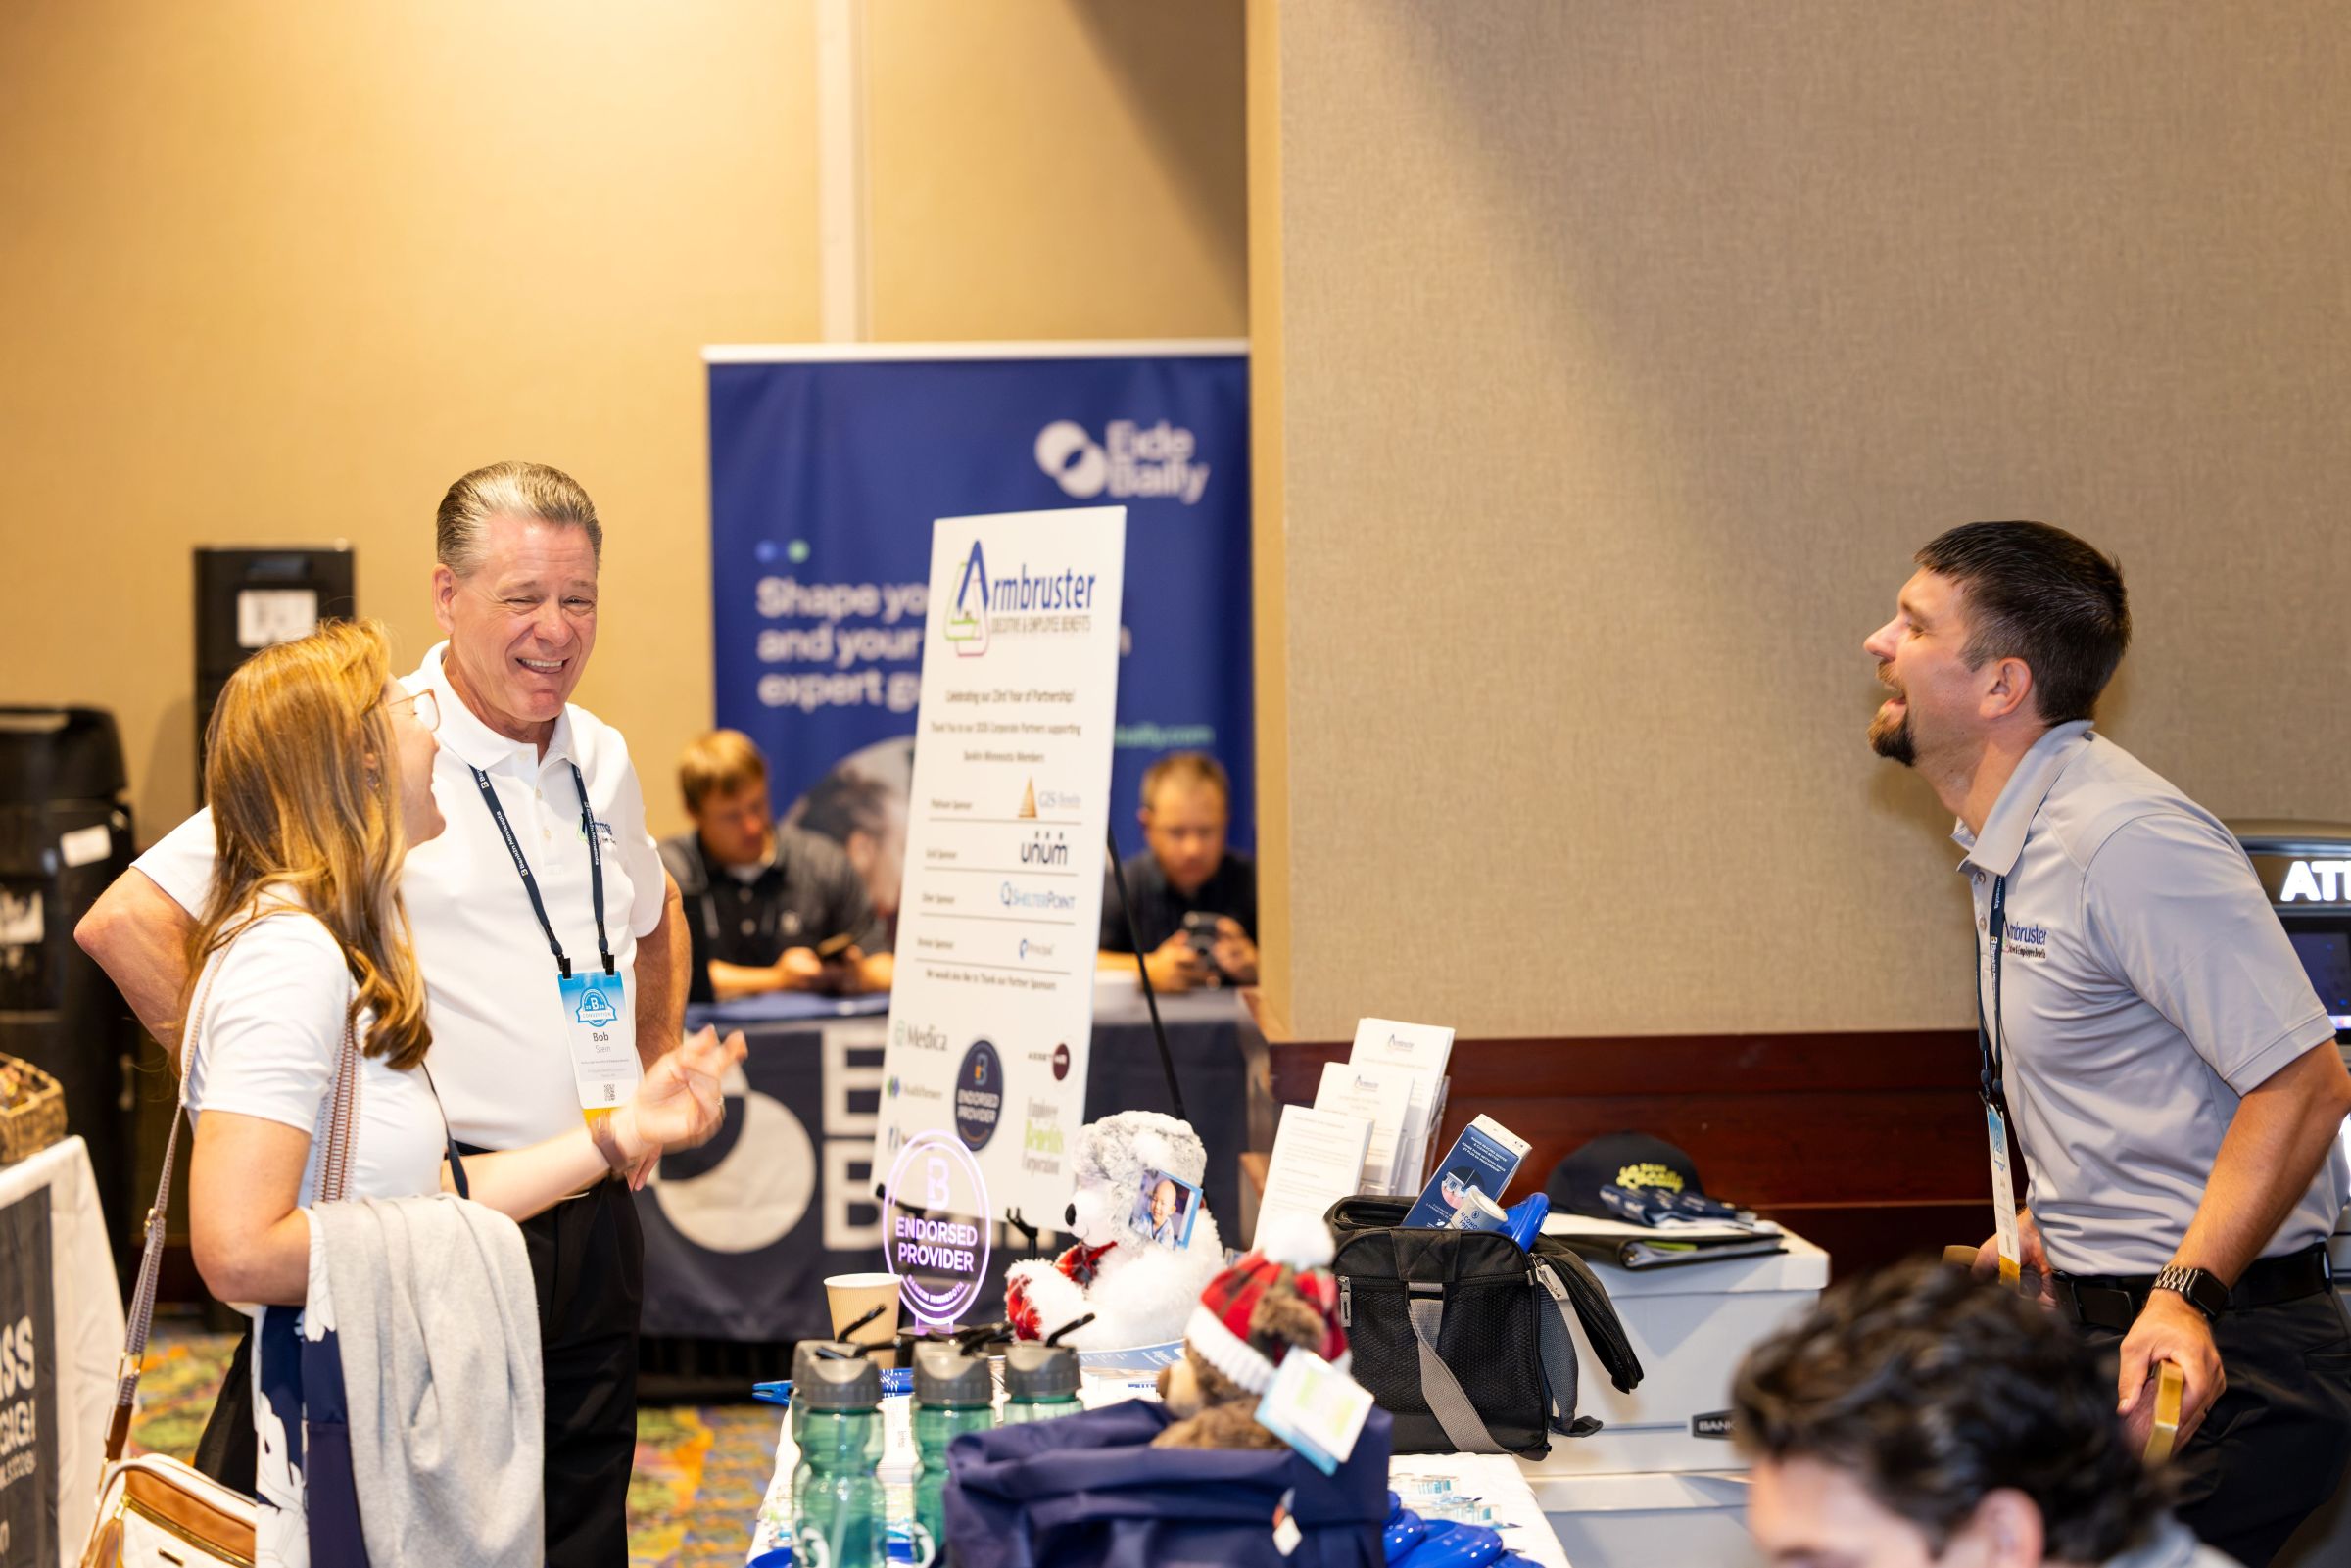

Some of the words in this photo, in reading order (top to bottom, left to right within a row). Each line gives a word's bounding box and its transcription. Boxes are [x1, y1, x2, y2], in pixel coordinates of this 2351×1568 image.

[1106, 420, 1194, 460] Eide
[957, 540, 1096, 612] Armbruster
[757, 576, 880, 624] Shape
[883, 583, 929, 624] yo
[757, 622, 832, 662] and
[758, 669, 883, 713] expert
[592, 1031, 609, 1042] Bob
[895, 1216, 979, 1247] ENDORSED
[1459, 1219, 1471, 1230] FRE
[897, 1242, 974, 1272] PROVIDER
[0, 1315, 35, 1401] SS
[1697, 1418, 1737, 1433] BANK
